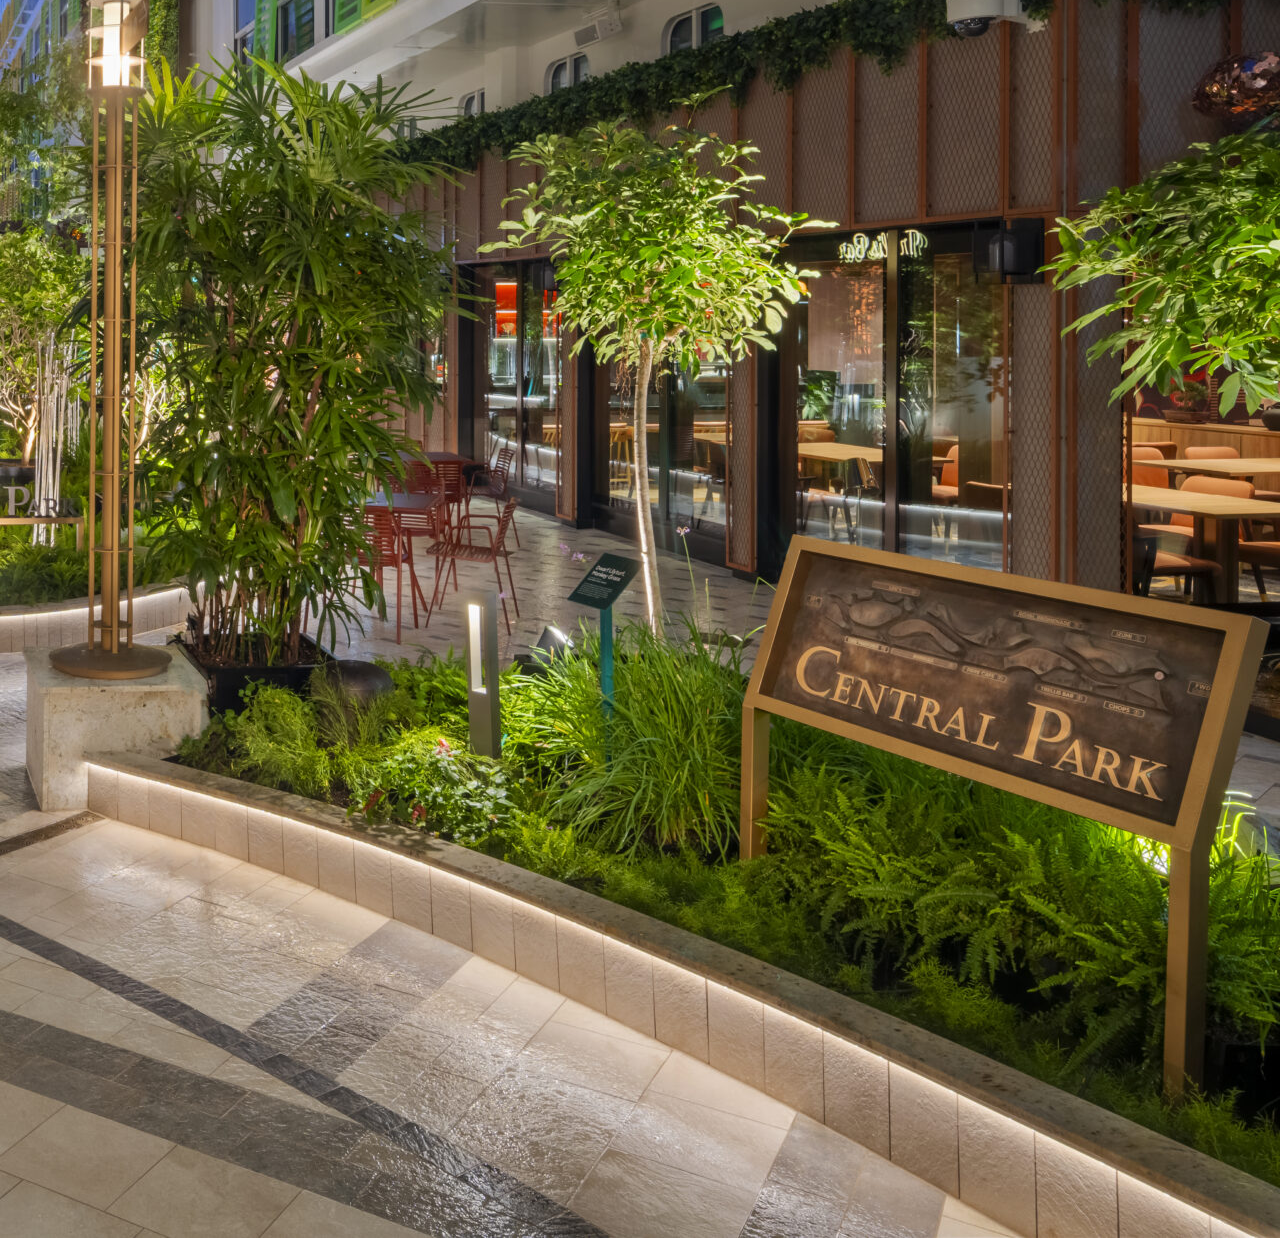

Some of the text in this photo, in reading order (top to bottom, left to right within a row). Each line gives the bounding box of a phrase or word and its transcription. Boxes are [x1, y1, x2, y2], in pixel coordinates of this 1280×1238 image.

[3, 486, 78, 517] PARK
[1040, 686, 1074, 700] TRELLIS BAR
[1108, 702, 1131, 714] CHOPS
[795, 645, 1168, 801] CENTRAL PARK
